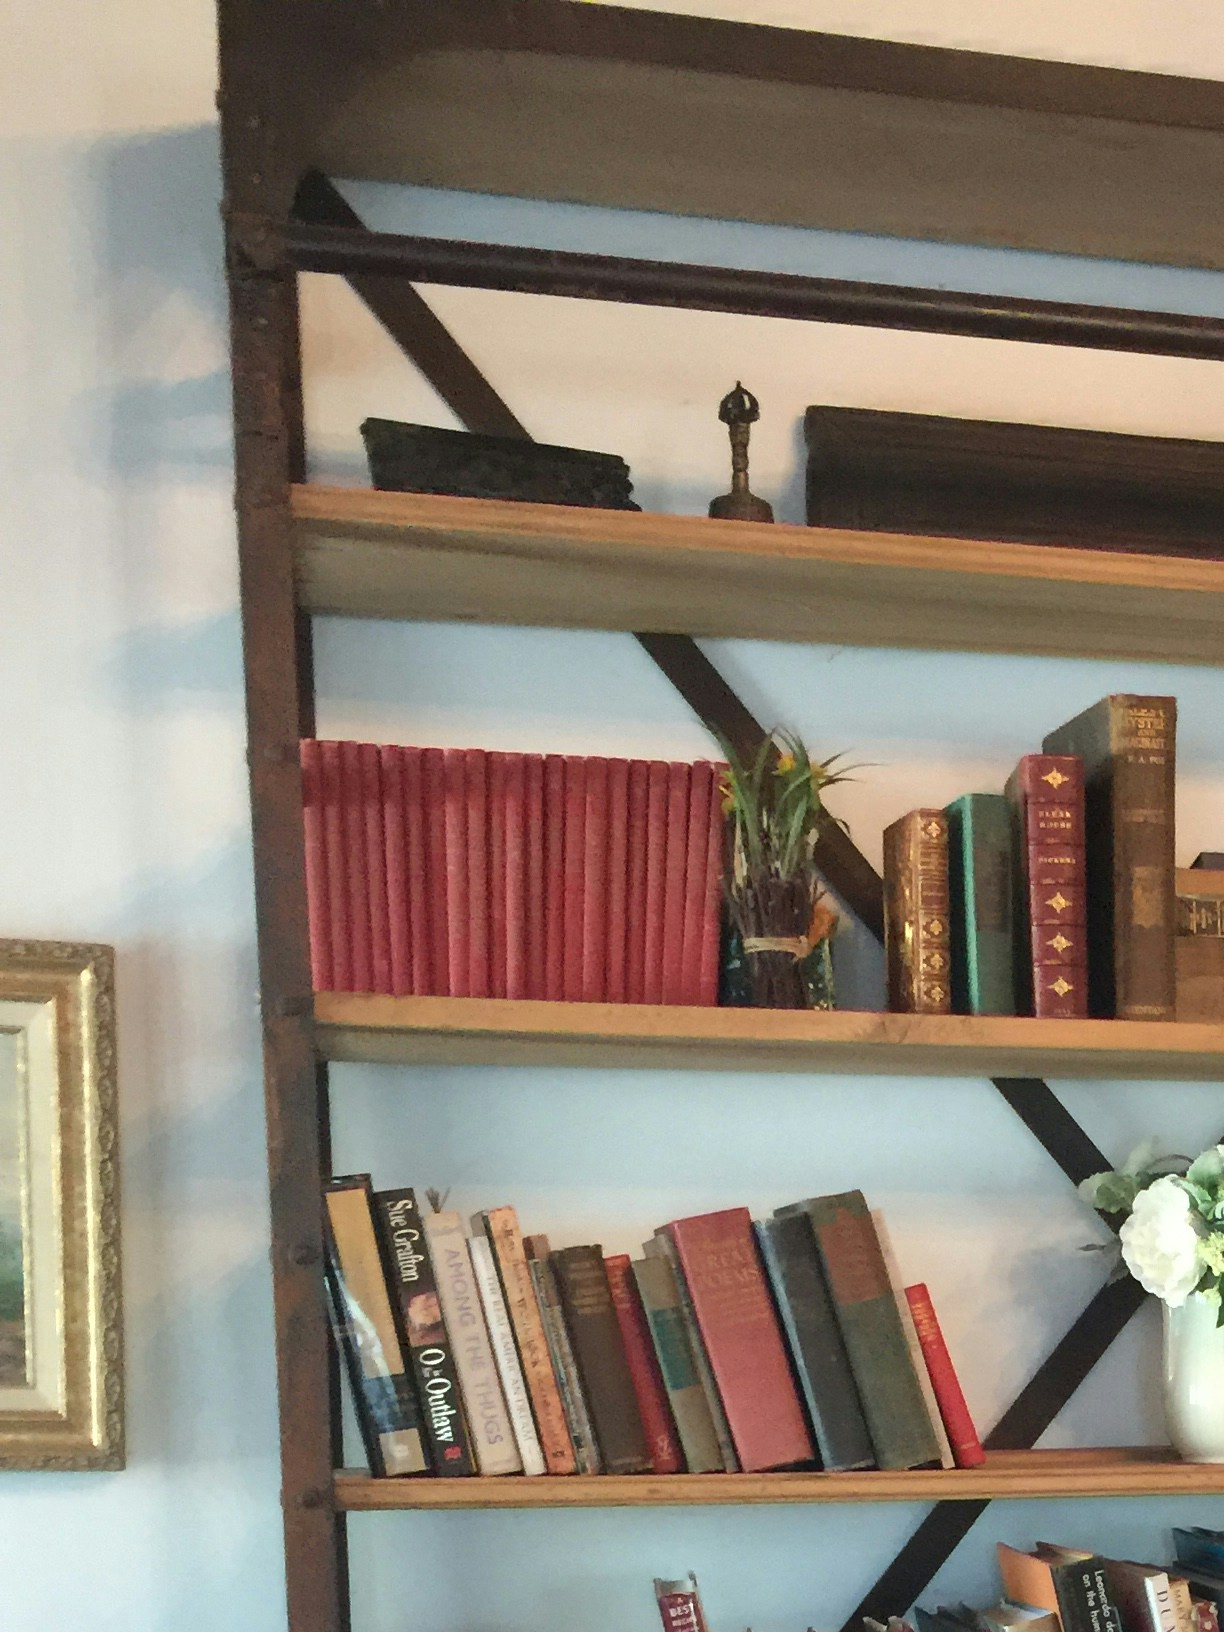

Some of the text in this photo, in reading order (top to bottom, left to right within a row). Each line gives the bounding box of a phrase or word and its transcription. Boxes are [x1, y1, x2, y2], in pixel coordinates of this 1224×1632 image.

[385, 1196, 428, 1283] Sue Grafton
[441, 1245, 506, 1446] AMONG THE THUGS
[423, 1374, 463, 1445] Outlaw
[1080, 1573, 1093, 1588] on
[1083, 1589, 1098, 1606] the
[1089, 1569, 1116, 1618] Leonardo
